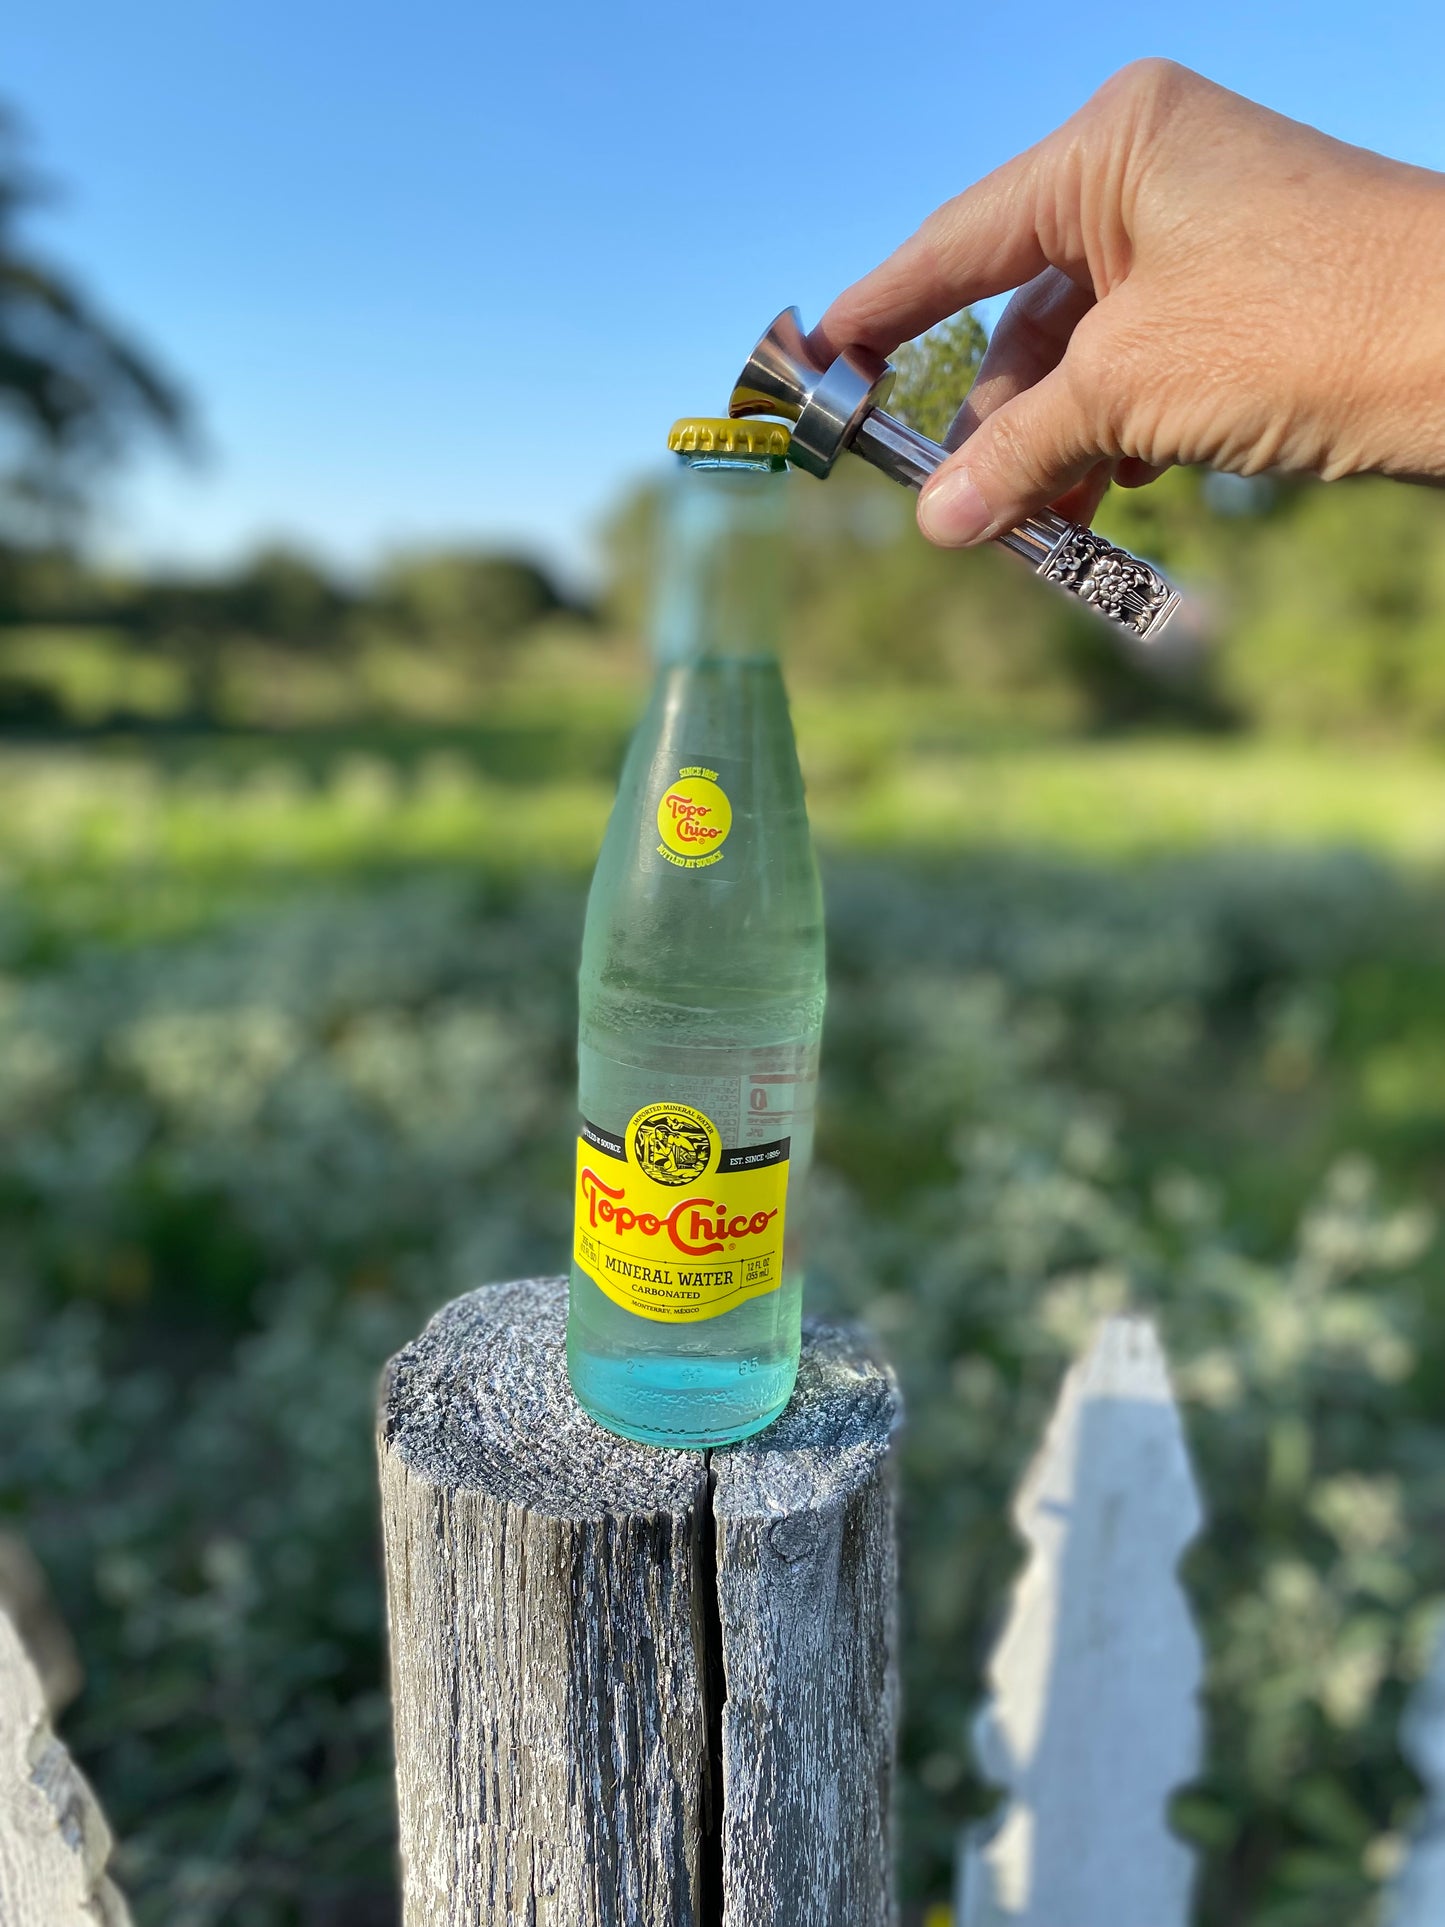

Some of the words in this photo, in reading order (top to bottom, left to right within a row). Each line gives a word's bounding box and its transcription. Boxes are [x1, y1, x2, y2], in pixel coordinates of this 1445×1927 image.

[679, 766, 702, 778] SINCE
[666, 795, 712, 819] Topo
[676, 818, 723, 842] Chico
[656, 843, 685, 867] BOTTLED
[685, 859, 695, 868] AT
[696, 850, 725, 868] SOURCE
[633, 1105, 662, 1126] IMPORTED
[663, 1104, 695, 1117] MINERAL
[696, 1114, 714, 1134] WATER
[601, 1138, 621, 1153] SOURCE
[730, 1157, 745, 1165] EST.
[745, 1153, 764, 1163] SINCE
[581, 1168, 668, 1235] Topo
[668, 1197, 778, 1256] Chico
[605, 1254, 673, 1285] MINERAL
[677, 1271, 733, 1286] WATER
[747, 1262, 754, 1271] 12
[755, 1260, 762, 1269] FL
[763, 1257, 770, 1267] OZ
[746, 1271, 758, 1281] (355
[631, 1284, 701, 1299] CARBONATED
[631, 1300, 672, 1314] MONTERREY,
[674, 1306, 700, 1314] MÉXICO
